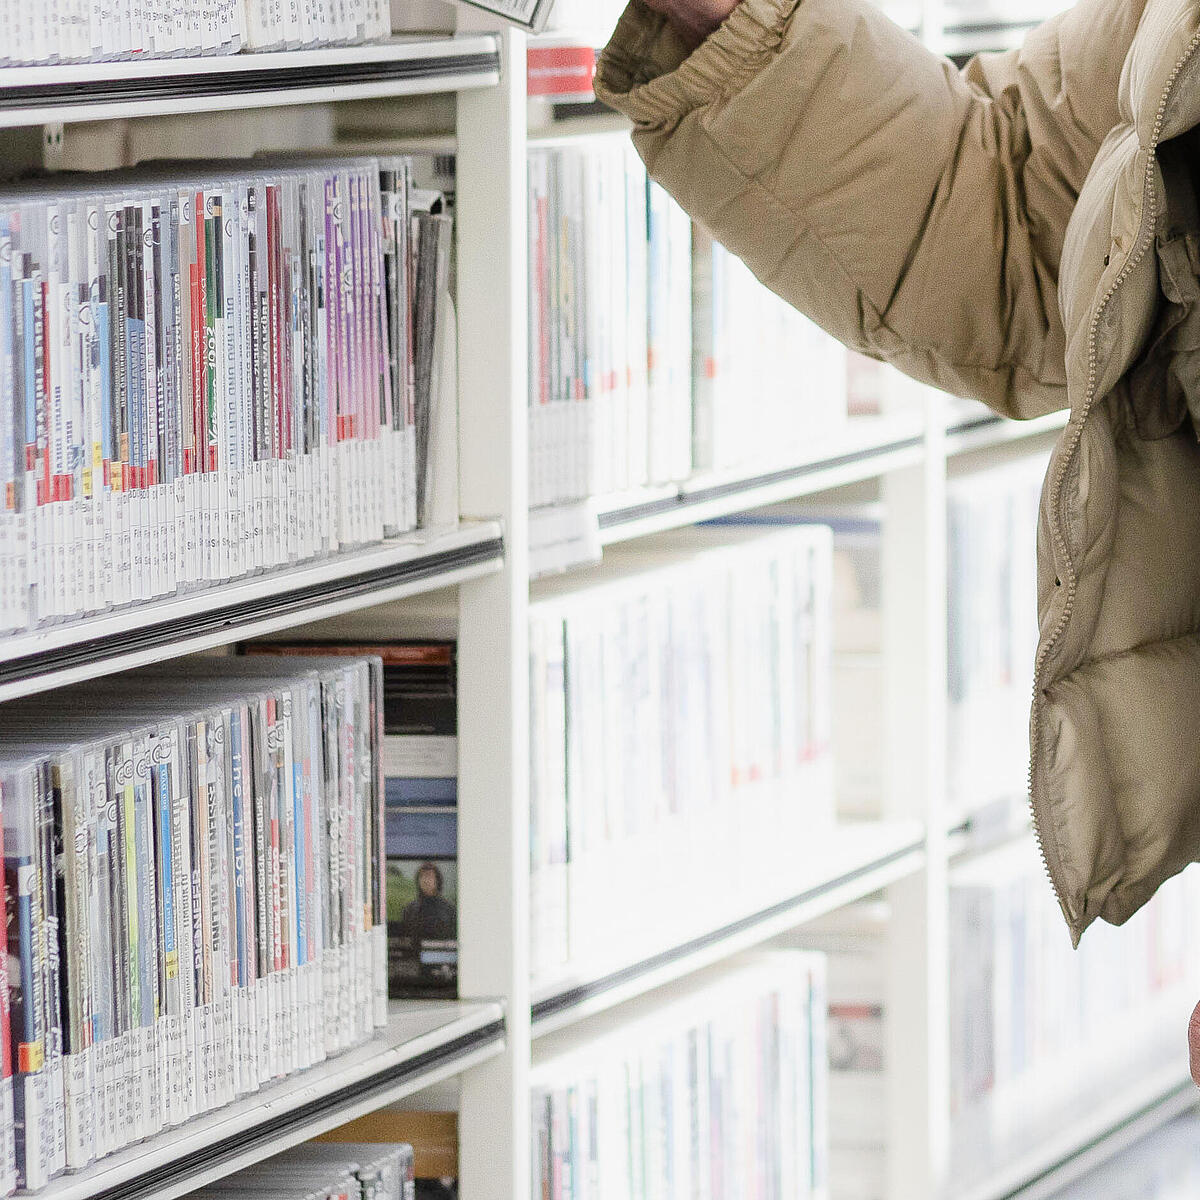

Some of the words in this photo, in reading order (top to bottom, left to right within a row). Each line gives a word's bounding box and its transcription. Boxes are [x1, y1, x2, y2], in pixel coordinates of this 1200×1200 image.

[262, 366, 270, 445] OPERATION
[232, 753, 243, 798] the
[234, 820, 245, 888] tribe
[210, 884, 220, 952] KILLING
